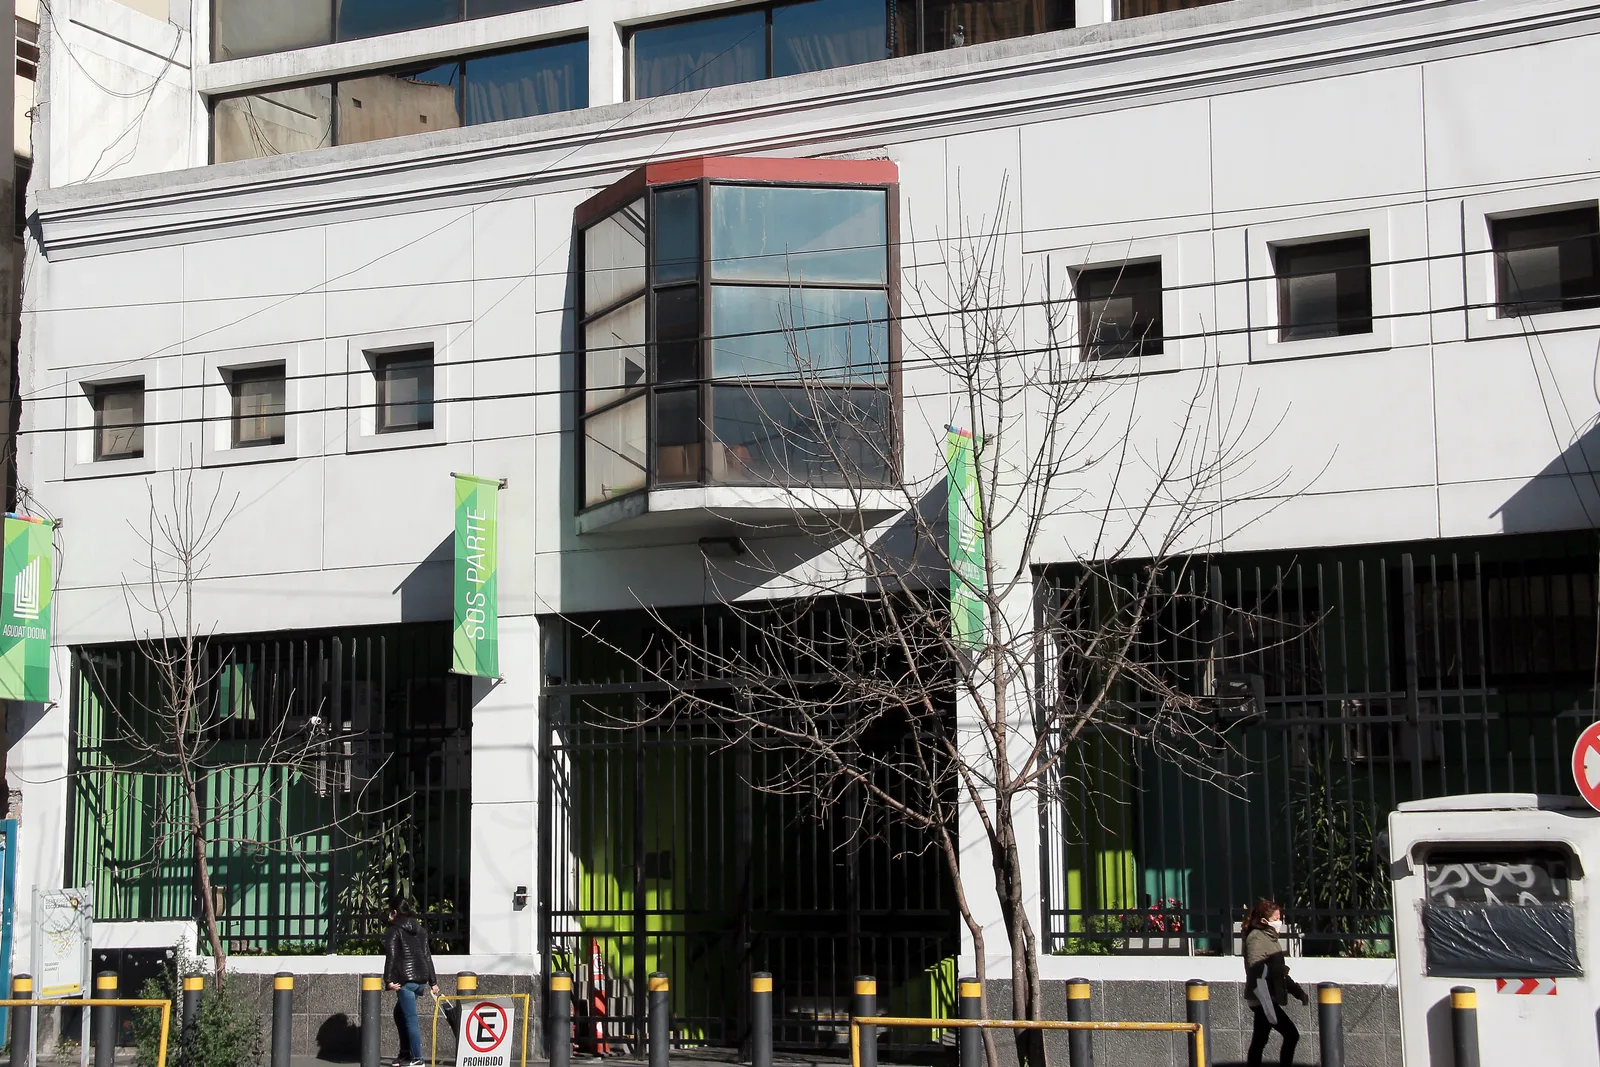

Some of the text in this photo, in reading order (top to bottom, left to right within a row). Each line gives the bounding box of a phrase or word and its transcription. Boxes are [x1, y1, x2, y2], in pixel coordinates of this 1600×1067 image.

[465, 506, 487, 641] SOS PARTE
[2, 624, 47, 640] AGUDAT DODIM
[476, 1011, 497, 1042] E
[462, 1056, 504, 1067] PROHIBIDO
